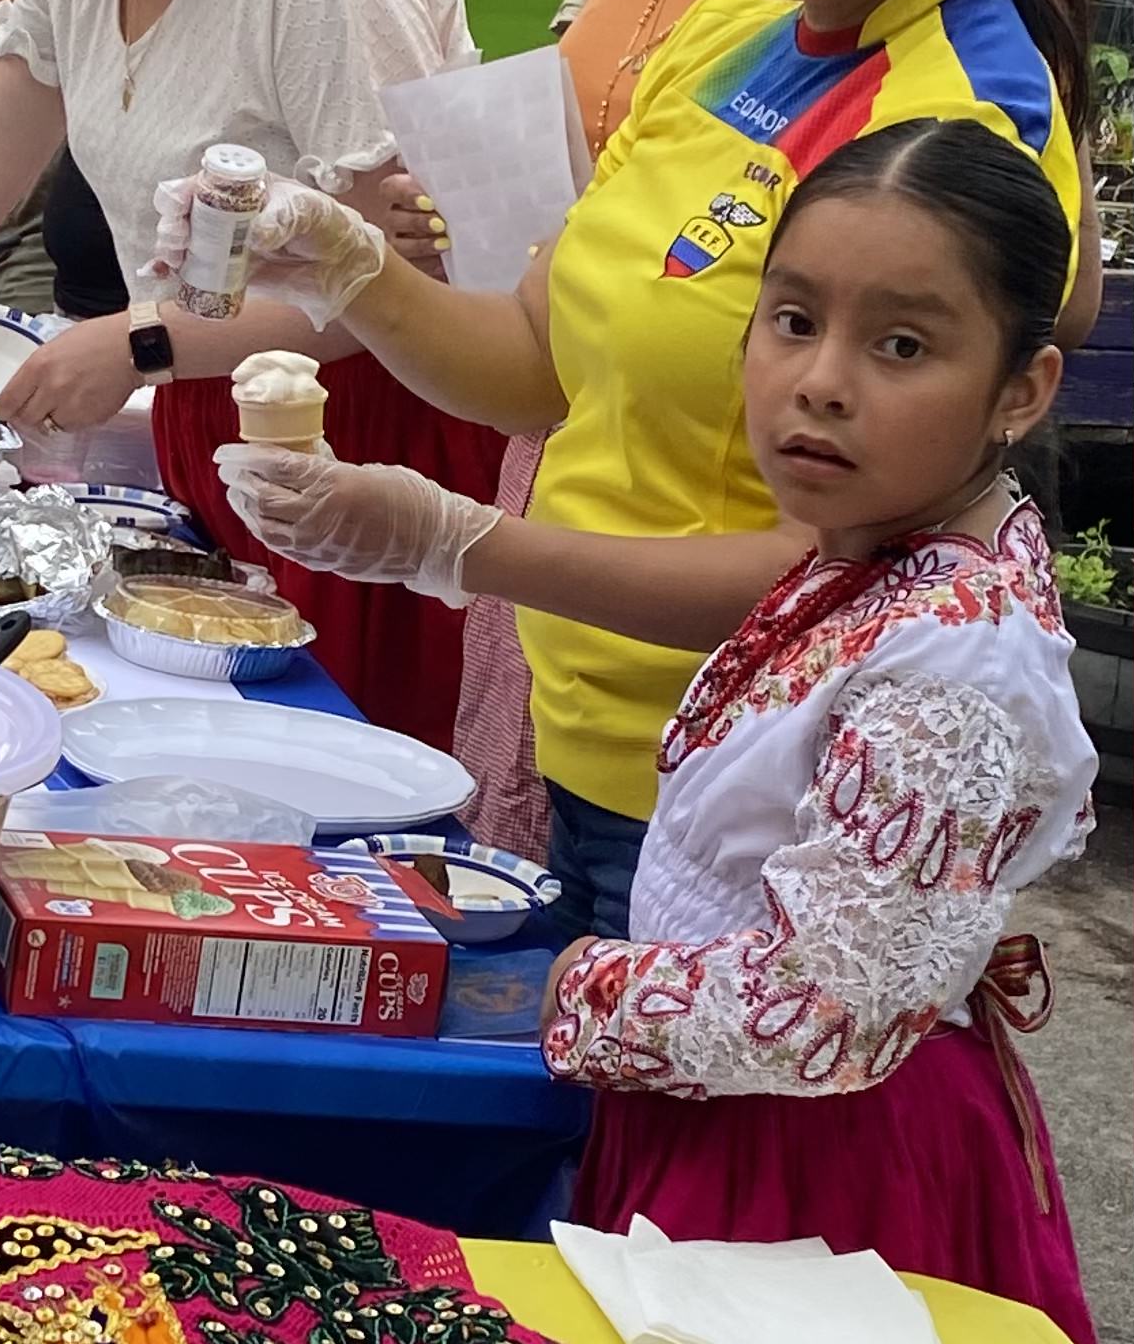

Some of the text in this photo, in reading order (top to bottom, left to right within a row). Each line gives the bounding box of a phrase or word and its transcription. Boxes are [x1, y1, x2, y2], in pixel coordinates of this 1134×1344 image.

[170, 843, 316, 928] CUPS
[259, 870, 295, 892] ICE
[378, 952, 399, 1021] CUPS
